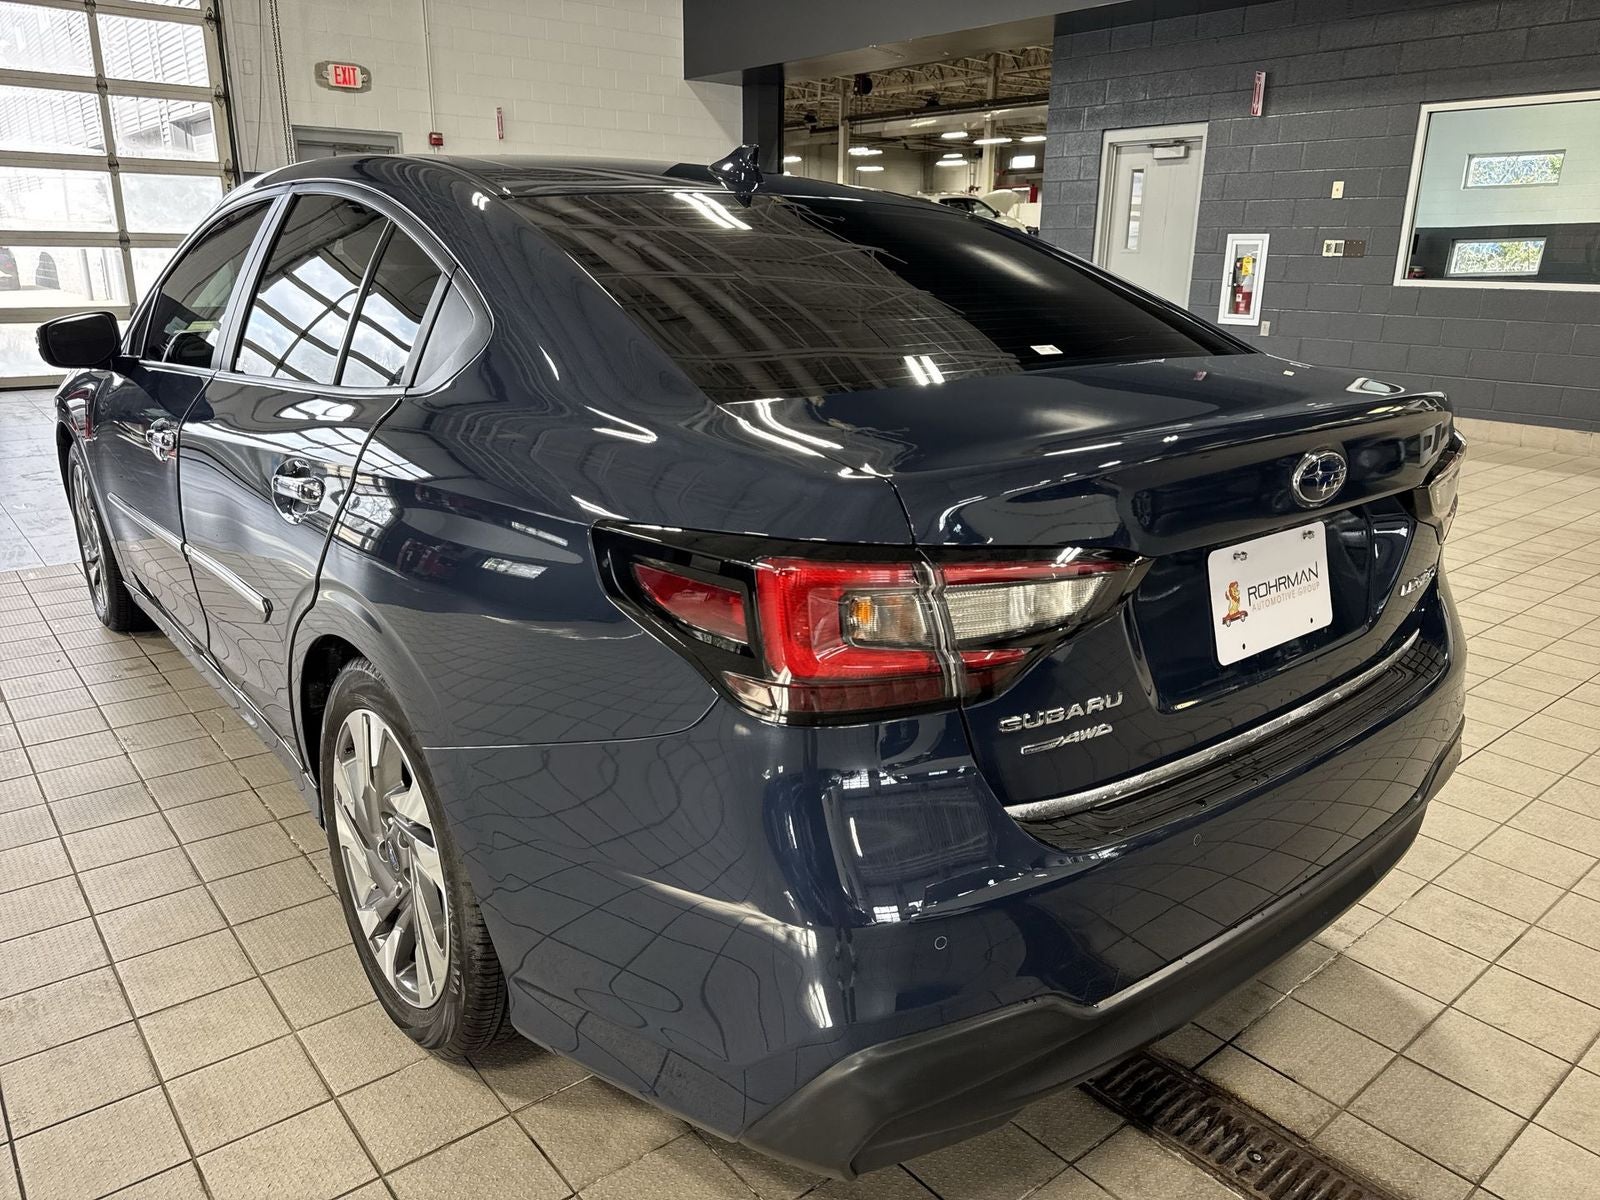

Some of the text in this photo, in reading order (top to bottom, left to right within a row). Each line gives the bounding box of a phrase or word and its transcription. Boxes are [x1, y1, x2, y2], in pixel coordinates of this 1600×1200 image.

[334, 66, 356, 86] EXIT
[1247, 561, 1319, 606] ROHRMAN
[1252, 581, 1320, 611] AUTOMOTIVE GROUP
[999, 691, 1123, 732] SUBARU
[1058, 723, 1113, 747] AWD
